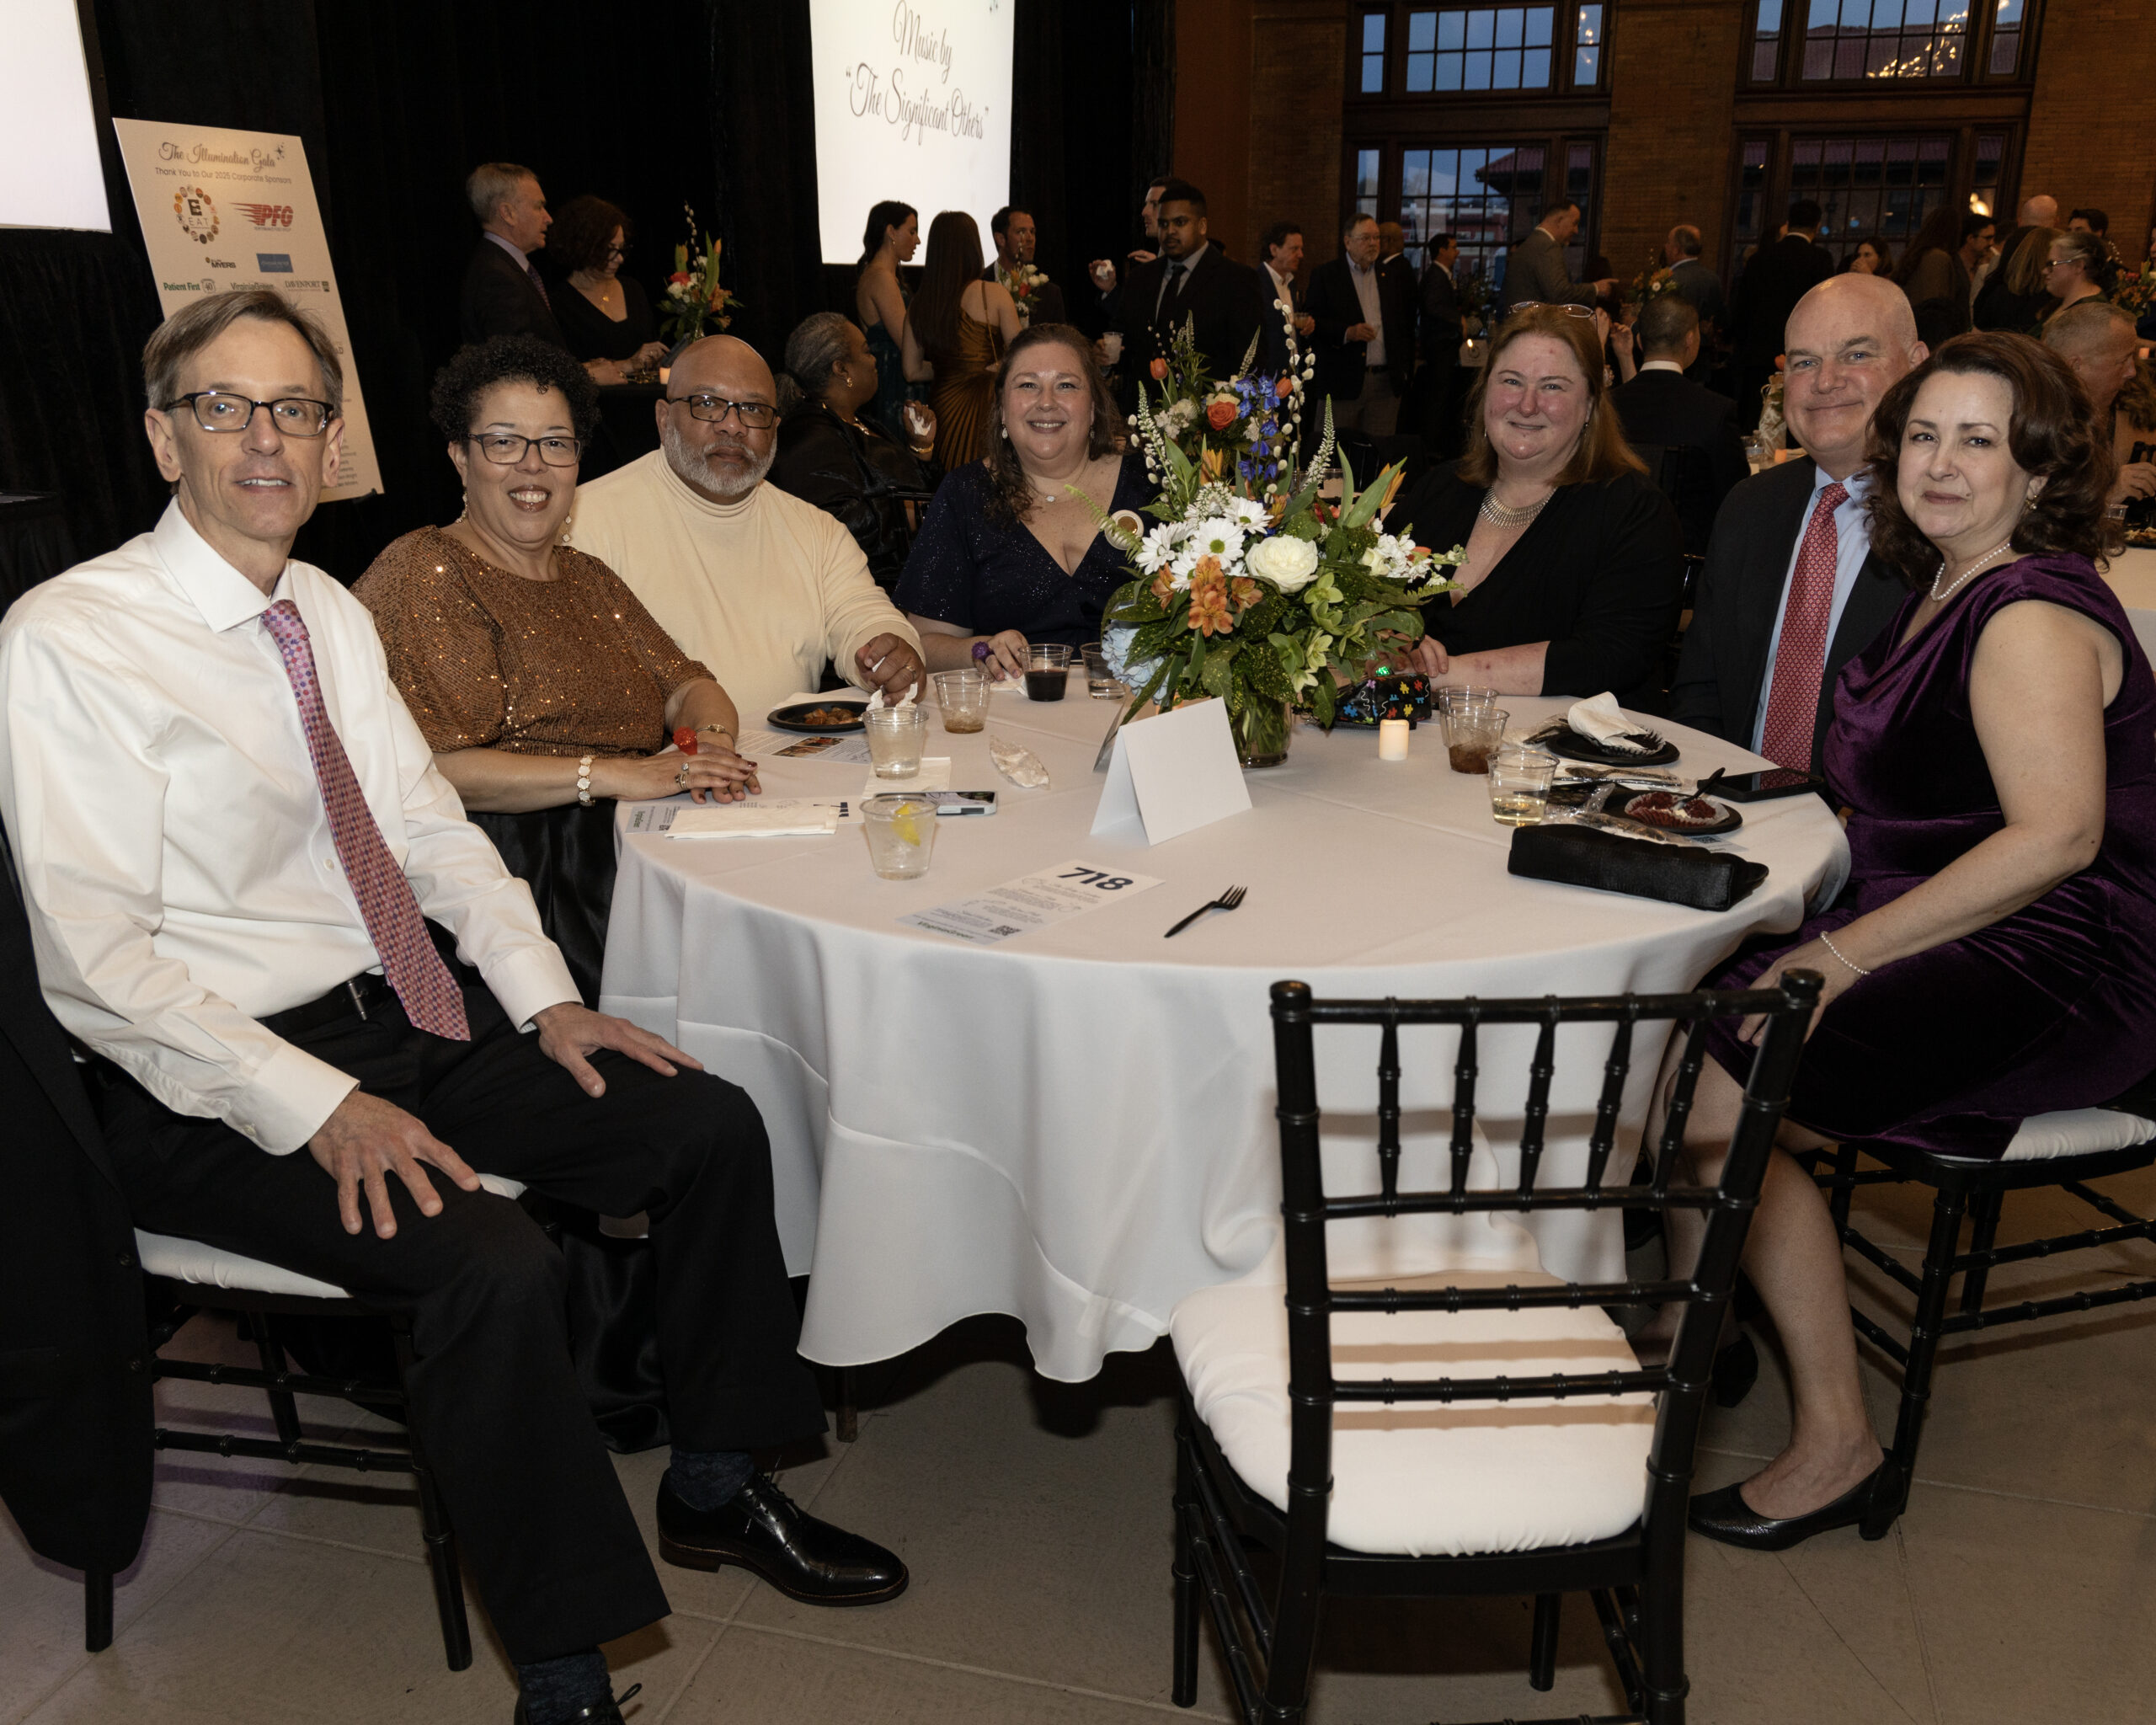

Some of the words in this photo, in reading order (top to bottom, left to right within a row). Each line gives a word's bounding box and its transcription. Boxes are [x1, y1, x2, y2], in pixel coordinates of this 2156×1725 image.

[894, 0, 937, 64] Music
[940, 28, 953, 84] by
[884, 68, 950, 146] Significant
[158, 142, 184, 160] The
[187, 143, 249, 165] Illumination
[250, 147, 275, 173] Gala
[155, 167, 176, 176] Thank
[178, 168, 191, 178] You
[193, 169, 200, 178] to
[201, 170, 213, 179] Our
[215, 171, 231, 180] 2025
[232, 172, 264, 183] Corporate
[264, 174, 291, 184] Sponsors
[189, 217, 209, 226] EAT
[258, 204, 294, 227] PFG
[163, 282, 186, 291] Patient
[187, 282, 200, 291] First
[1057, 867, 1134, 890] 718
